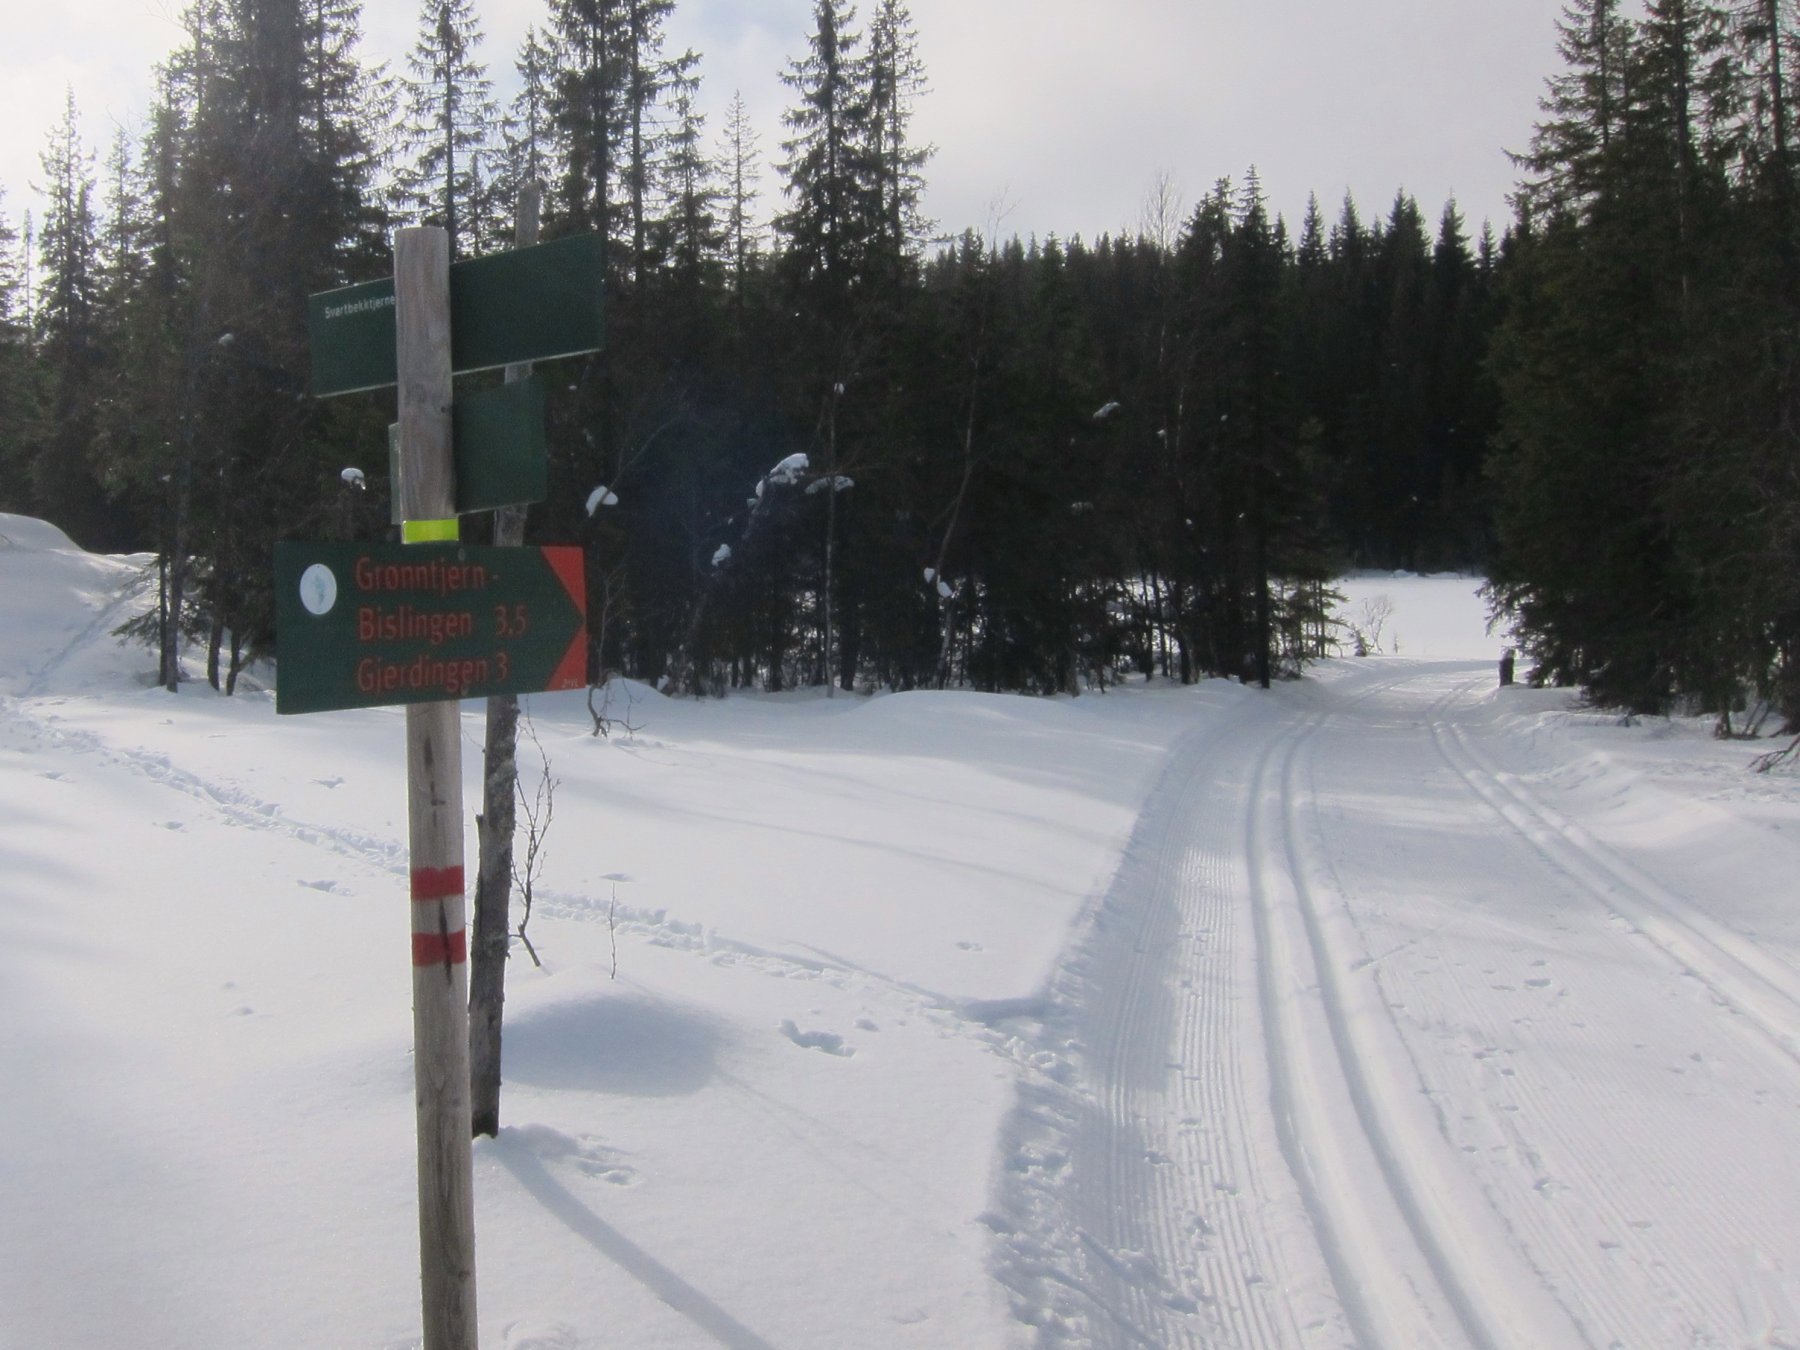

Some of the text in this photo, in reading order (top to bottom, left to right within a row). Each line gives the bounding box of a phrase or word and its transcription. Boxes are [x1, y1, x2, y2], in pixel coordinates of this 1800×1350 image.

[358, 604, 472, 645] Bislingen
[357, 651, 508, 695] Gjerdingen 3
